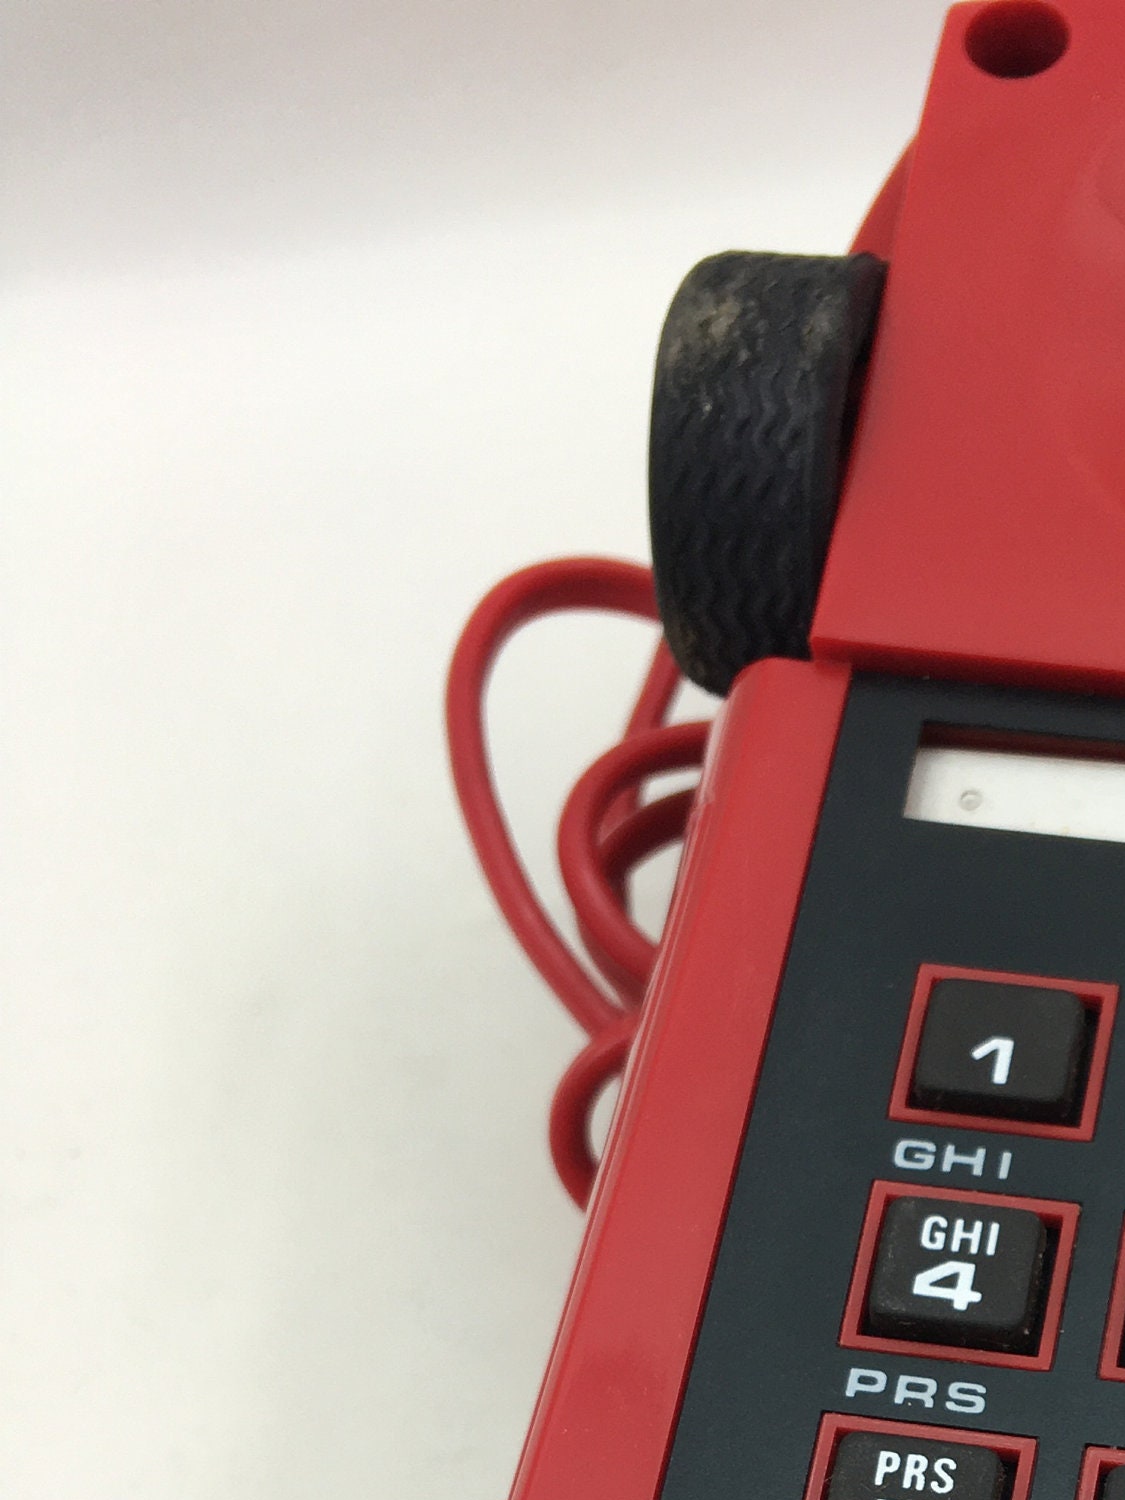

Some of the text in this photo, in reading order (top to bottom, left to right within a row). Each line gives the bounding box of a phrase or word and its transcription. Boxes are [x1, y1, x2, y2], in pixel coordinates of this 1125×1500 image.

[971, 1036, 1015, 1085] 1
[893, 1139, 1012, 1179] GHI
[920, 1215, 1000, 1256] GHI
[911, 1260, 983, 1311] 4
[845, 1367, 987, 1414] PRS
[874, 1450, 957, 1494] PRS
